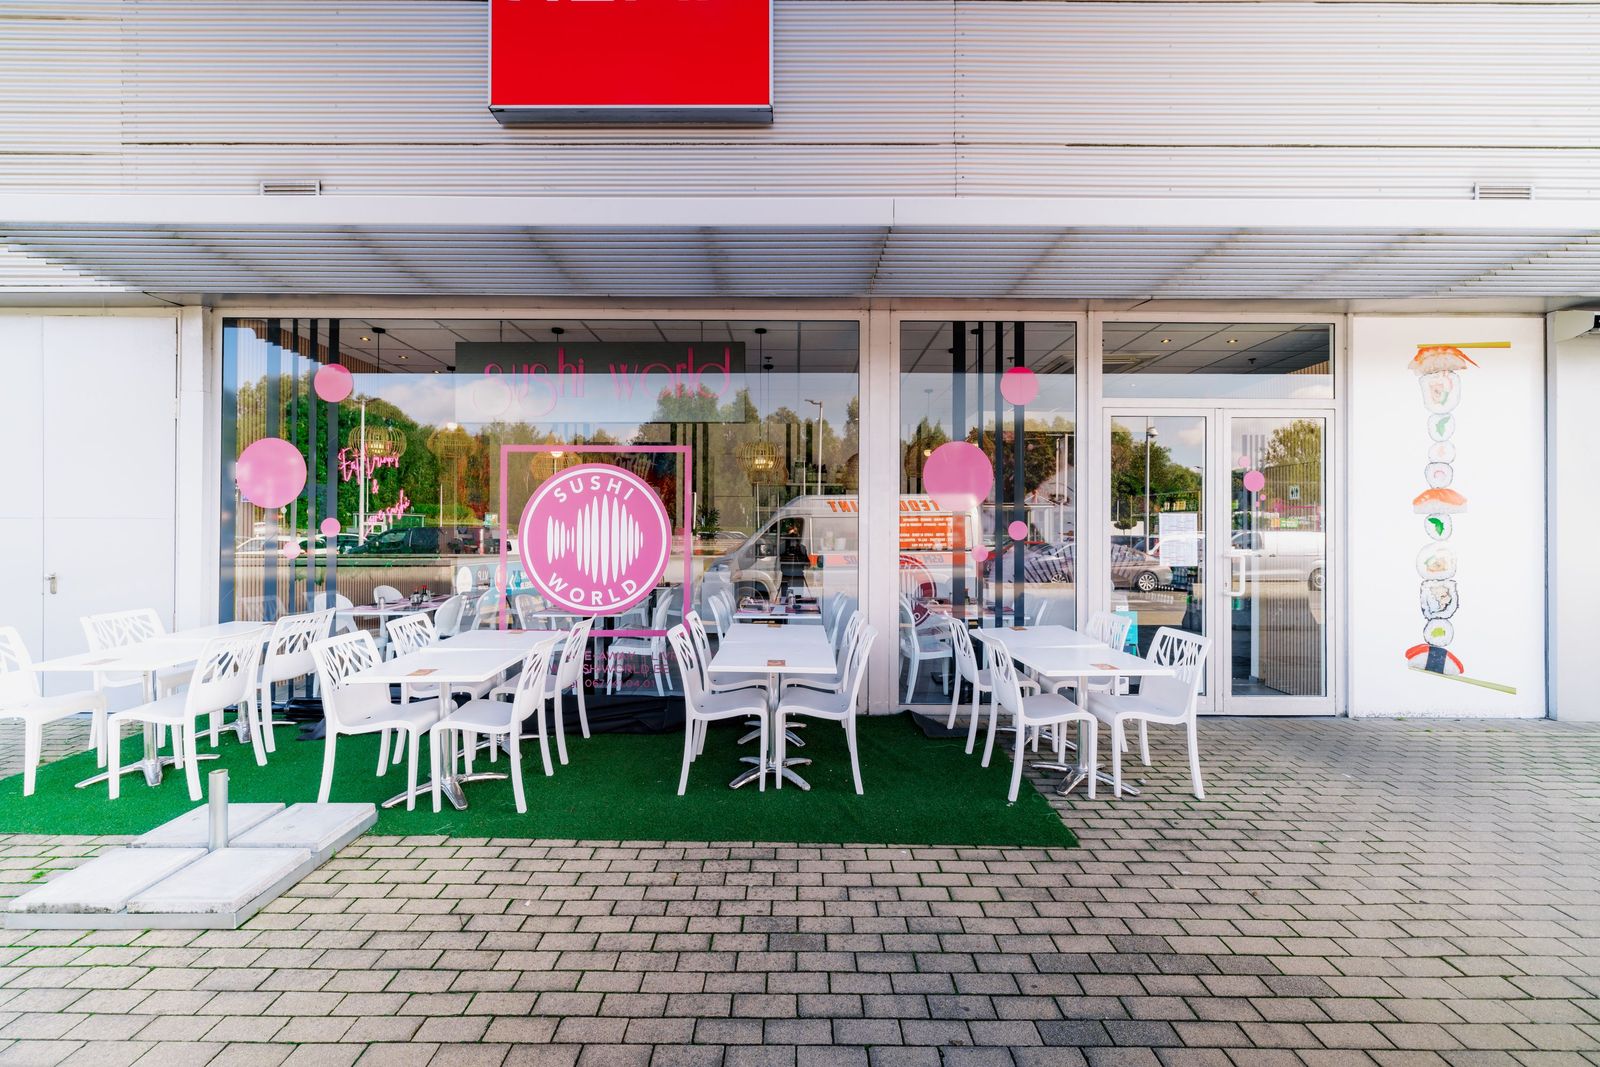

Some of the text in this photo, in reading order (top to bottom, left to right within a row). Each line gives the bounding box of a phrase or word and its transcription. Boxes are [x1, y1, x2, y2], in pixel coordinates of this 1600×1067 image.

[473, 347, 732, 417] sushi world
[554, 475, 634, 503] SUSHI
[548, 572, 637, 605] WORLD
